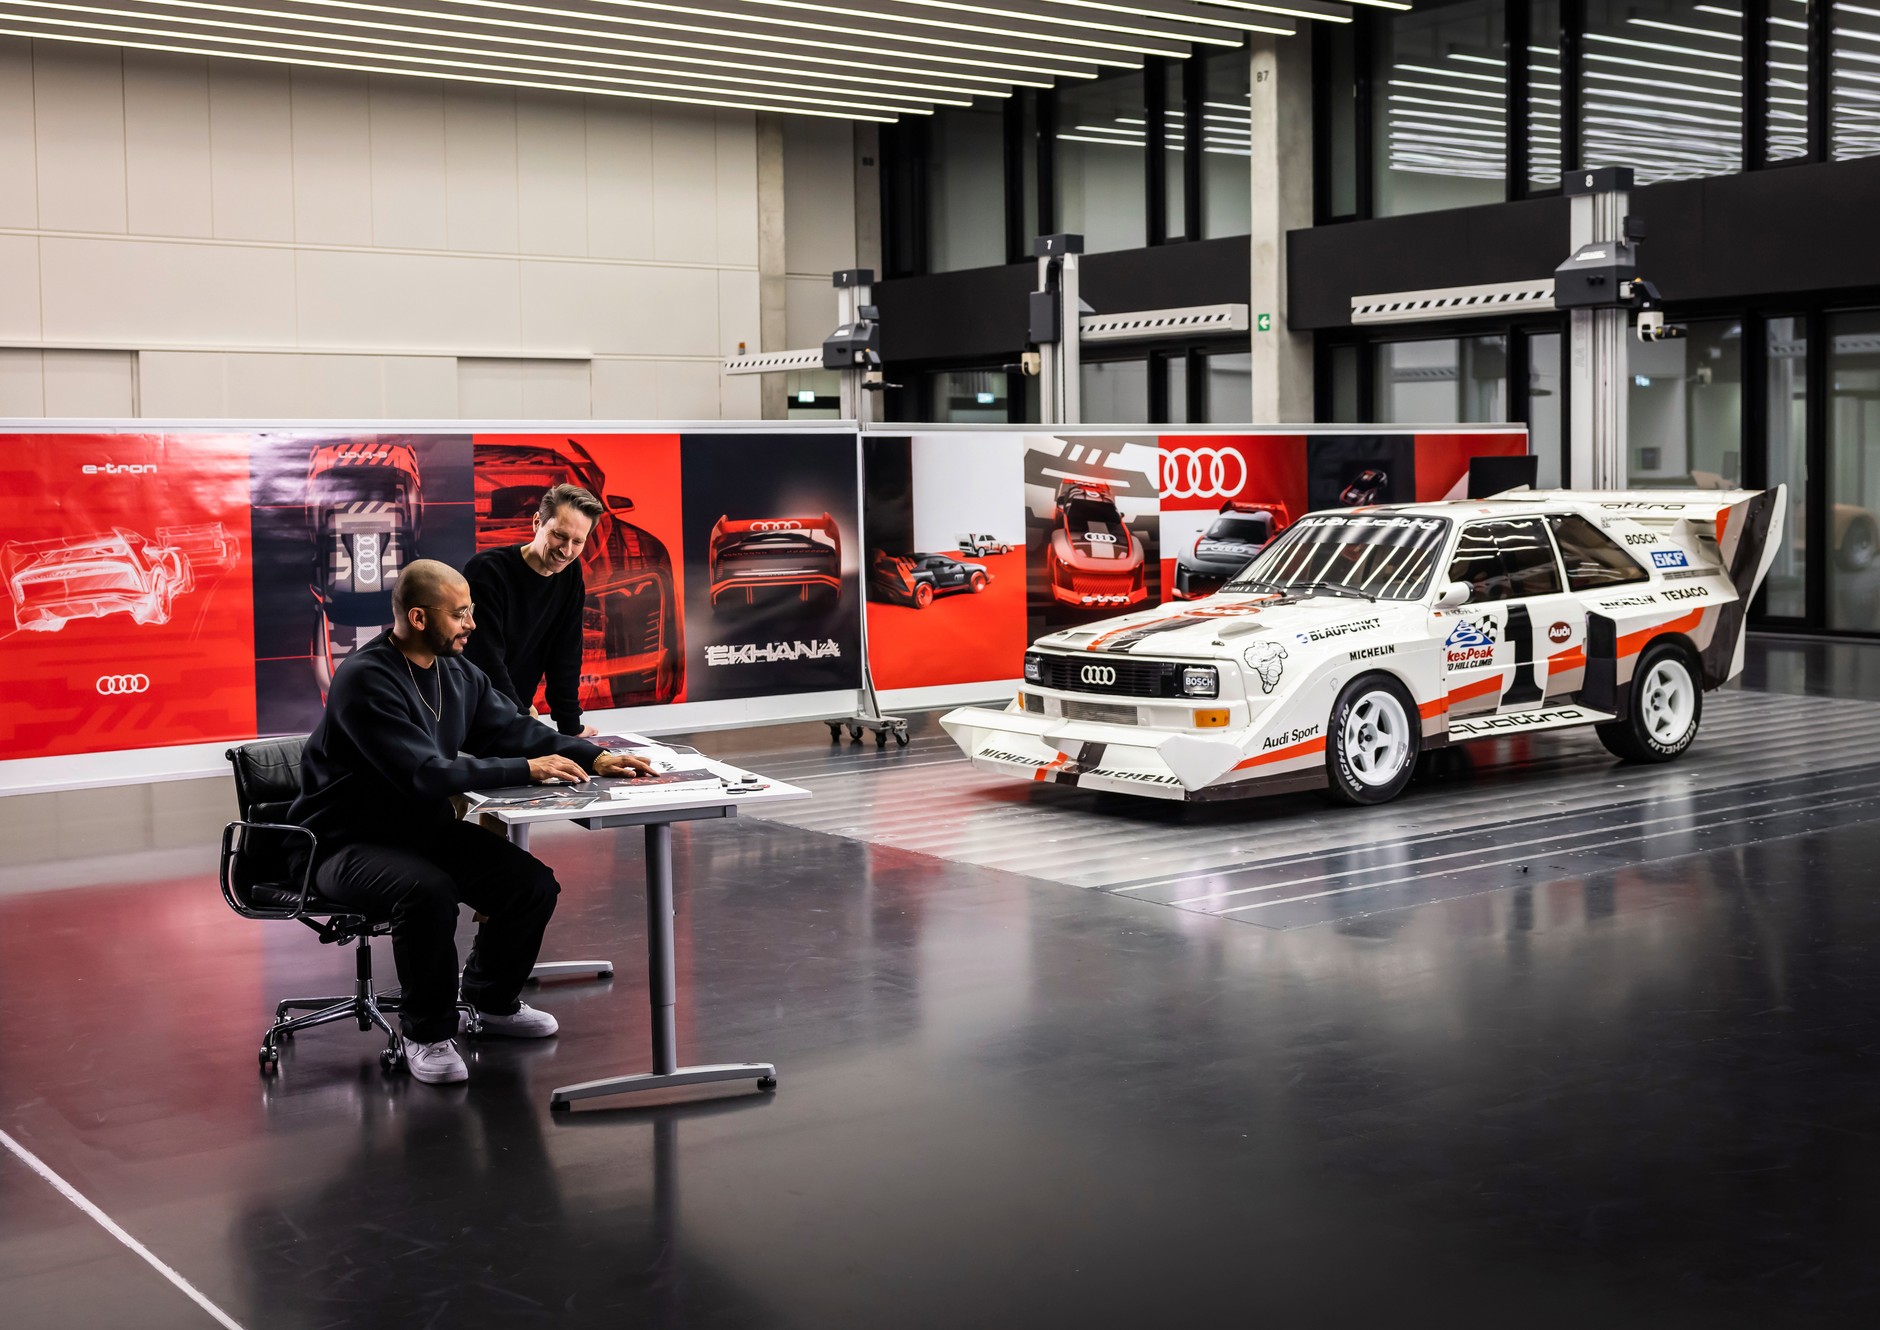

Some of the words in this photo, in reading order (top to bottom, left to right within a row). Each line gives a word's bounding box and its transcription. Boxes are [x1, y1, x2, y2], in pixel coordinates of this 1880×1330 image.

[1256, 69, 1269, 82] B7
[1585, 174, 1594, 187] 8
[82, 463, 157, 474] e-tron
[1625, 533, 1659, 546] BOSCH
[1653, 551, 1686, 567] SKF
[1082, 594, 1129, 603] e-tron
[1661, 586, 1708, 601] TEXACO
[1309, 618, 1380, 642] BLAUPUNKT
[1549, 626, 1571, 638] Audi
[1349, 644, 1395, 661] MICHELIN
[1447, 650, 1466, 662] kes
[1466, 646, 1494, 660] Peak
[1501, 603, 1544, 706] 1
[1454, 661, 1469, 670] HILL
[1470, 658, 1493, 668] CLIMB
[1185, 676, 1214, 687] BOSCH
[1449, 710, 1583, 735] quattro
[1262, 732, 1289, 750] Audi
[1291, 724, 1319, 742] Sport
[1647, 720, 1697, 754] MICHELIN
[1336, 703, 1363, 792] MICHELIN
[978, 748, 1050, 767] MICHELIN
